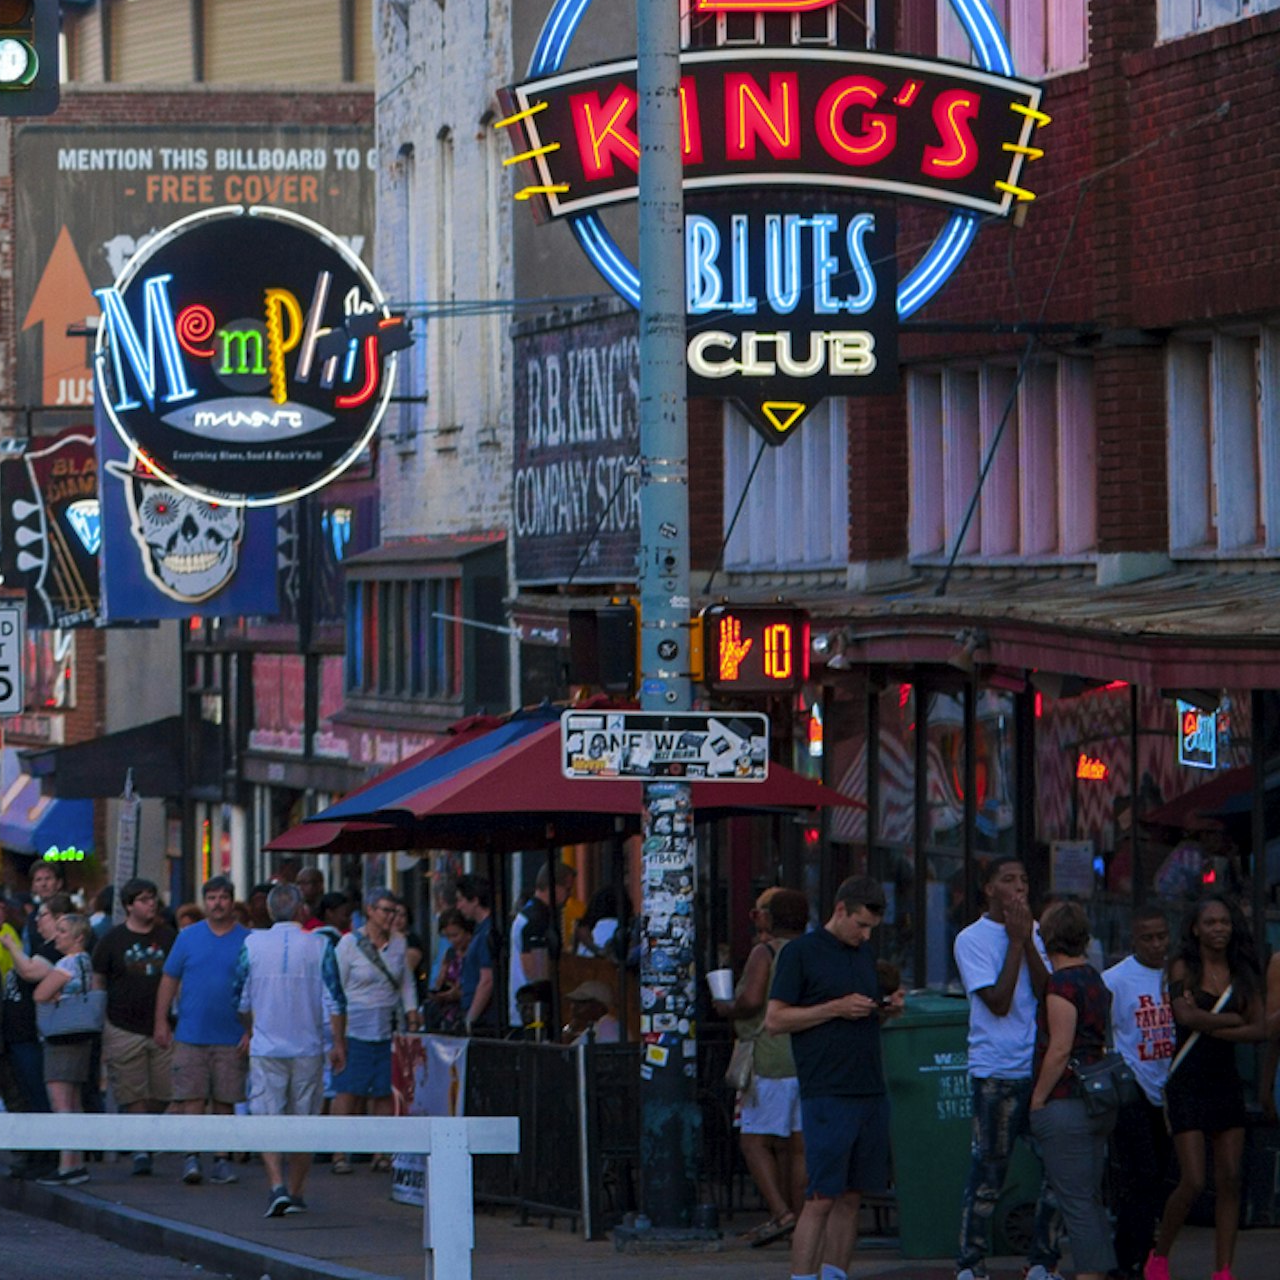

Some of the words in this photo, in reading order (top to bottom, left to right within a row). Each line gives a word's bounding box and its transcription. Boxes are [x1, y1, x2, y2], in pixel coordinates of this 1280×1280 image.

[57, 148, 153, 171] MENTION
[160, 148, 208, 170] THIS
[214, 148, 327, 171] BILLBOARD
[334, 148, 359, 171] TO
[146, 176, 214, 203] FREE
[224, 176, 318, 203] COVER
[685, 213, 878, 315] BLUES
[686, 329, 878, 379] CLUB
[514, 458, 591, 537] COMPANY
[764, 624, 791, 678] 10
